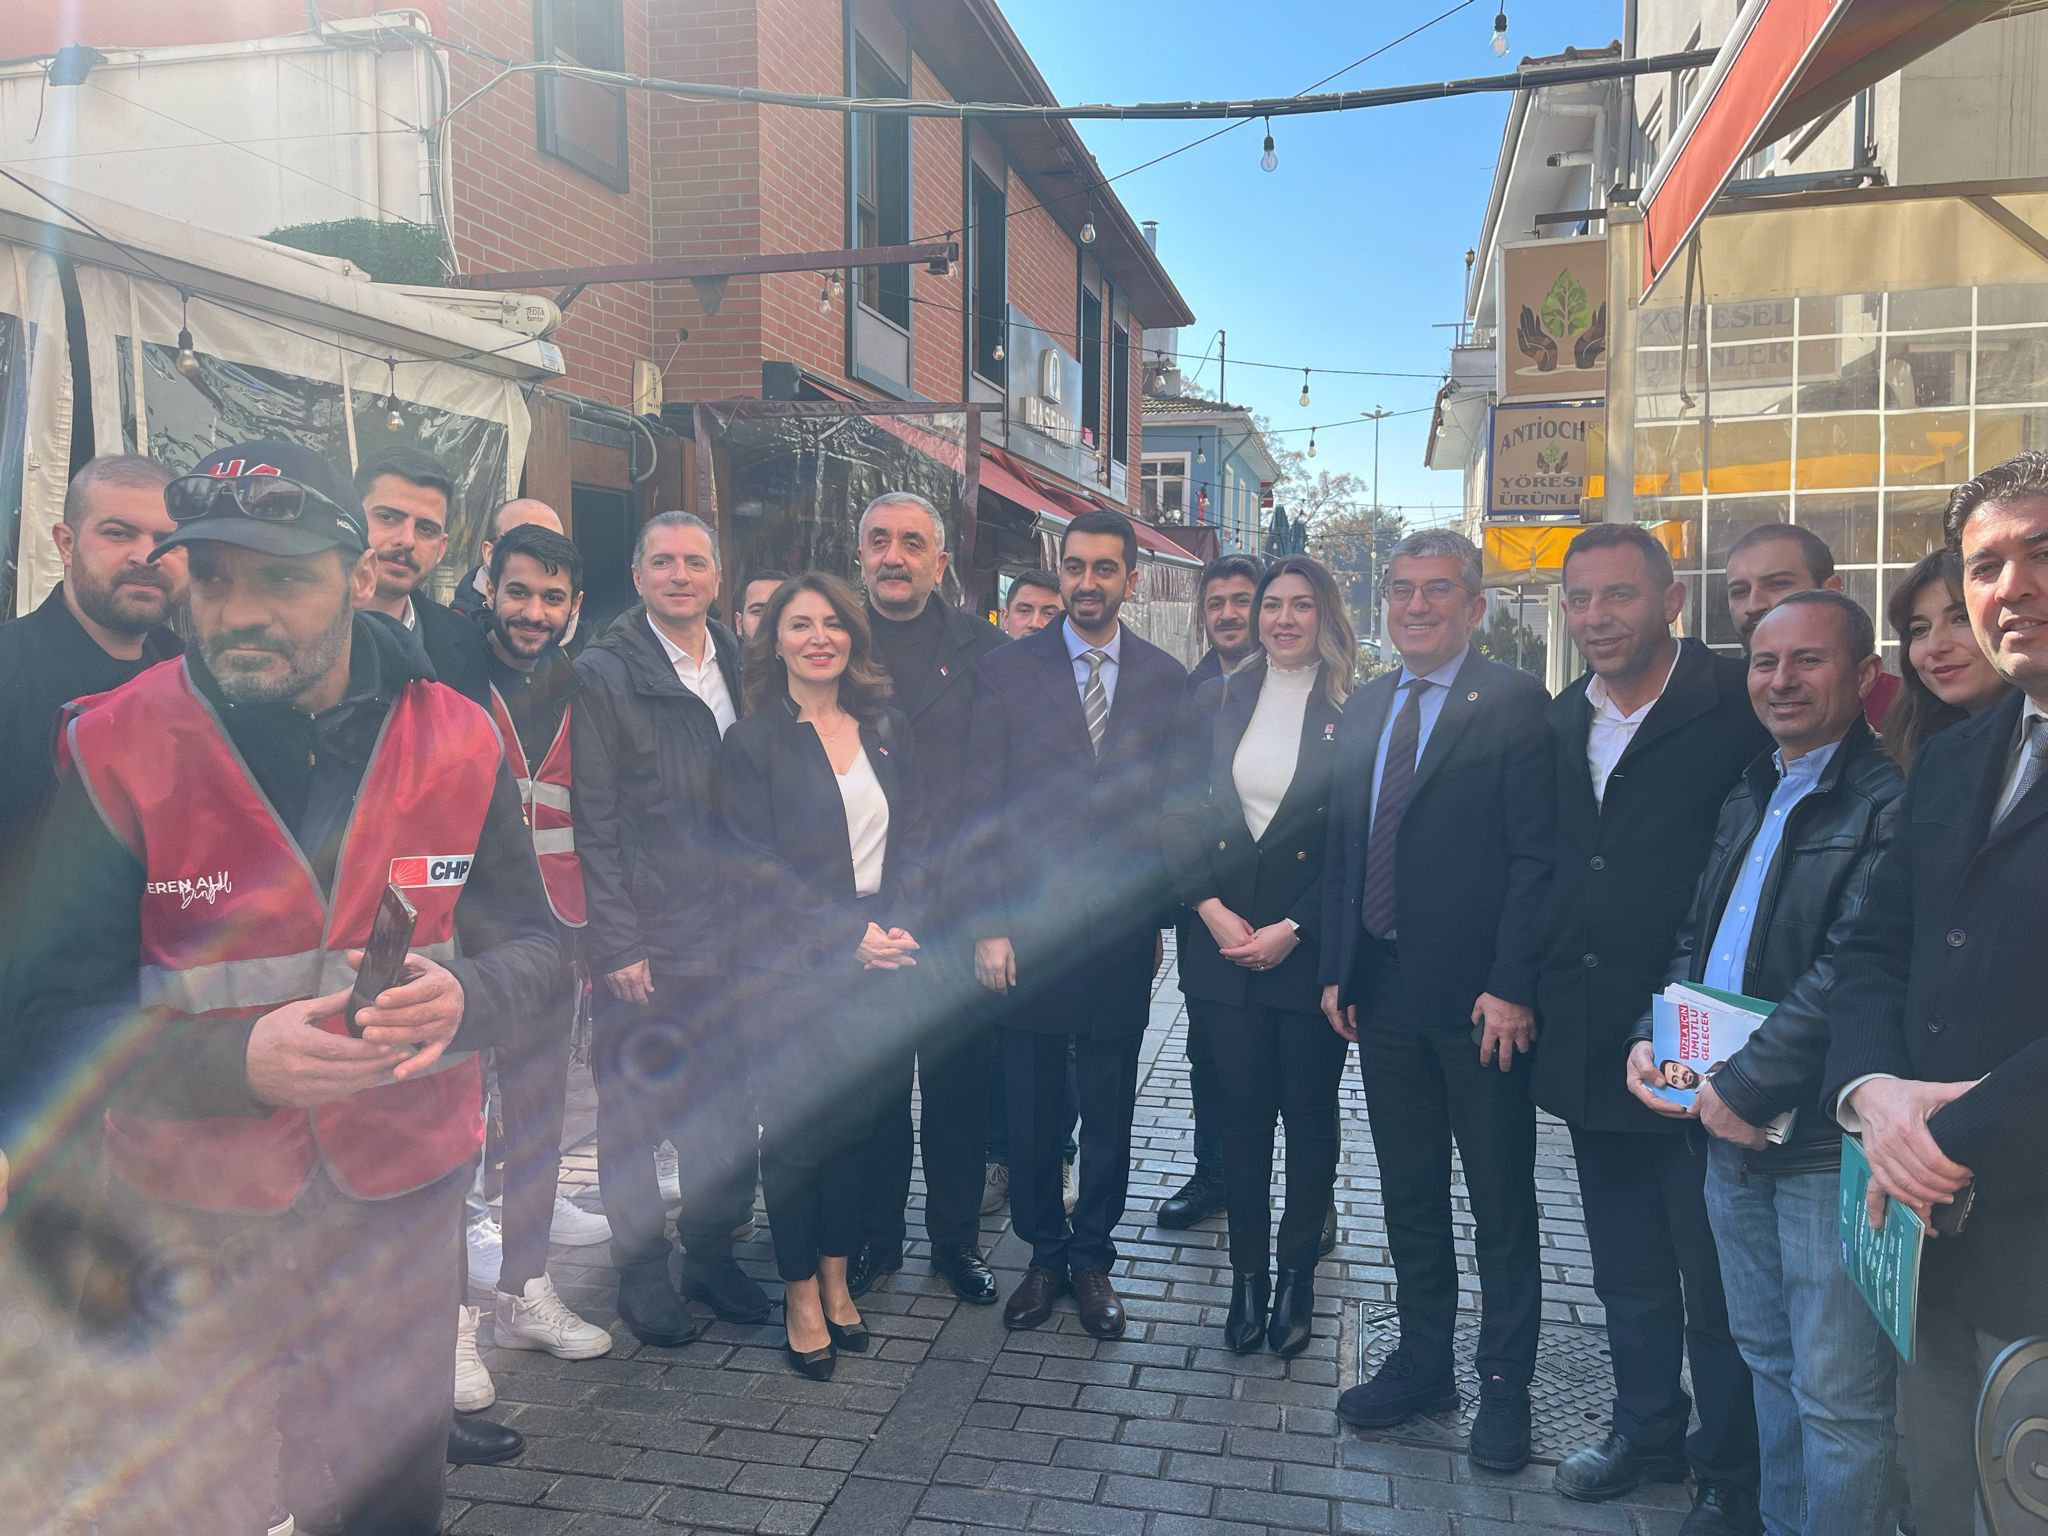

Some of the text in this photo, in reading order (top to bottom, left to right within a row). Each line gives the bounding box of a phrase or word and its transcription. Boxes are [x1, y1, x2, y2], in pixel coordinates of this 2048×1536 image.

[147, 879, 192, 894] EREN
[430, 861, 470, 880] CHP
[1680, 1027, 1689, 1059] TUZLA
[1690, 1009, 1699, 1059] UMUTLU
[1701, 1011, 1709, 1060] GELECEK
